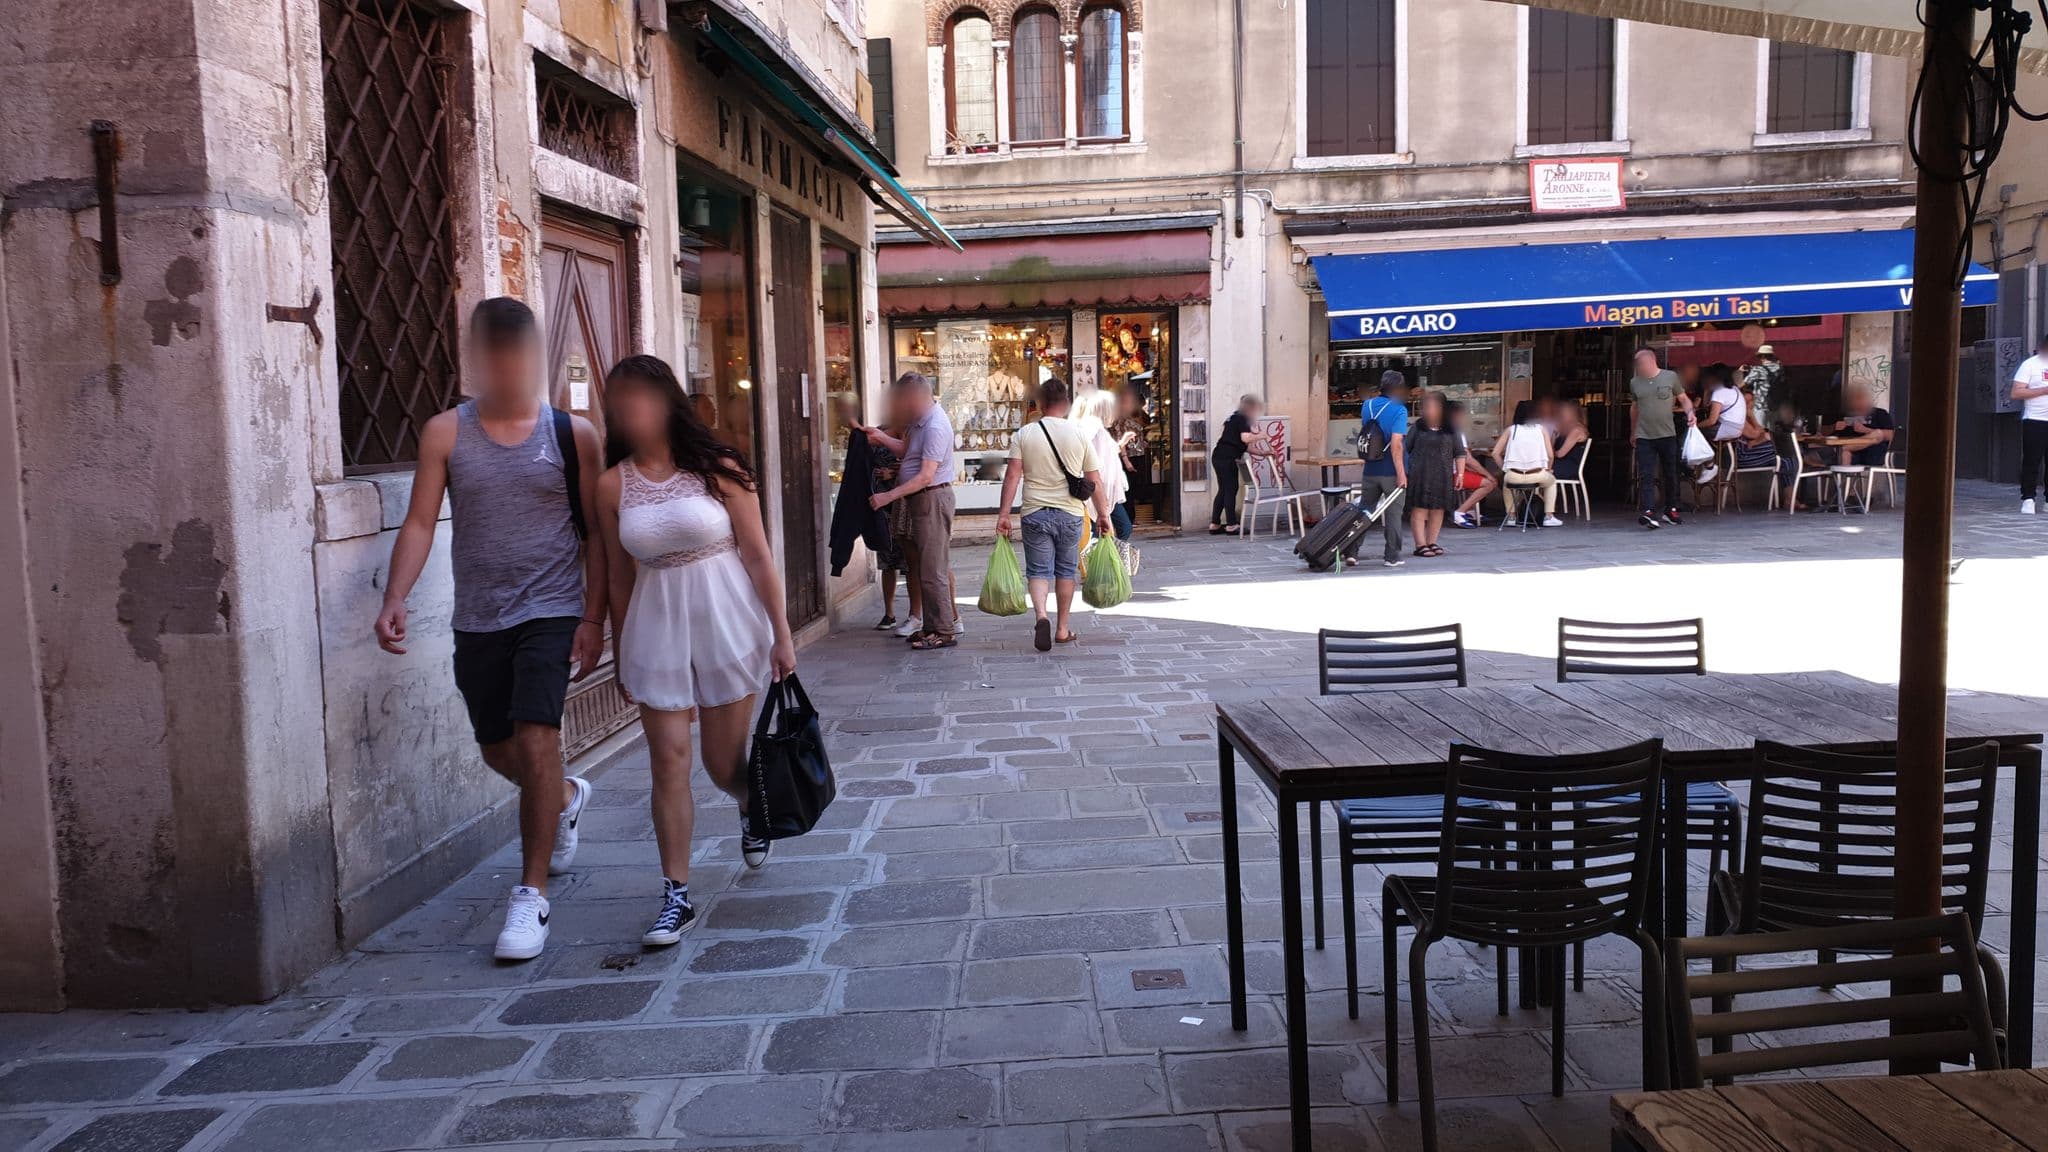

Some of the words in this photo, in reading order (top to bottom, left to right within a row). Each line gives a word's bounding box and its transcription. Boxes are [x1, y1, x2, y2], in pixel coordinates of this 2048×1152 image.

[717, 96, 844, 221] FARMACIA
[1542, 182, 1584, 194] ARONNE
[1584, 304, 1663, 324] Magna
[1672, 297, 1719, 318] Bevi
[1727, 295, 1769, 315] Tasi
[1360, 312, 1456, 335] BACARO
